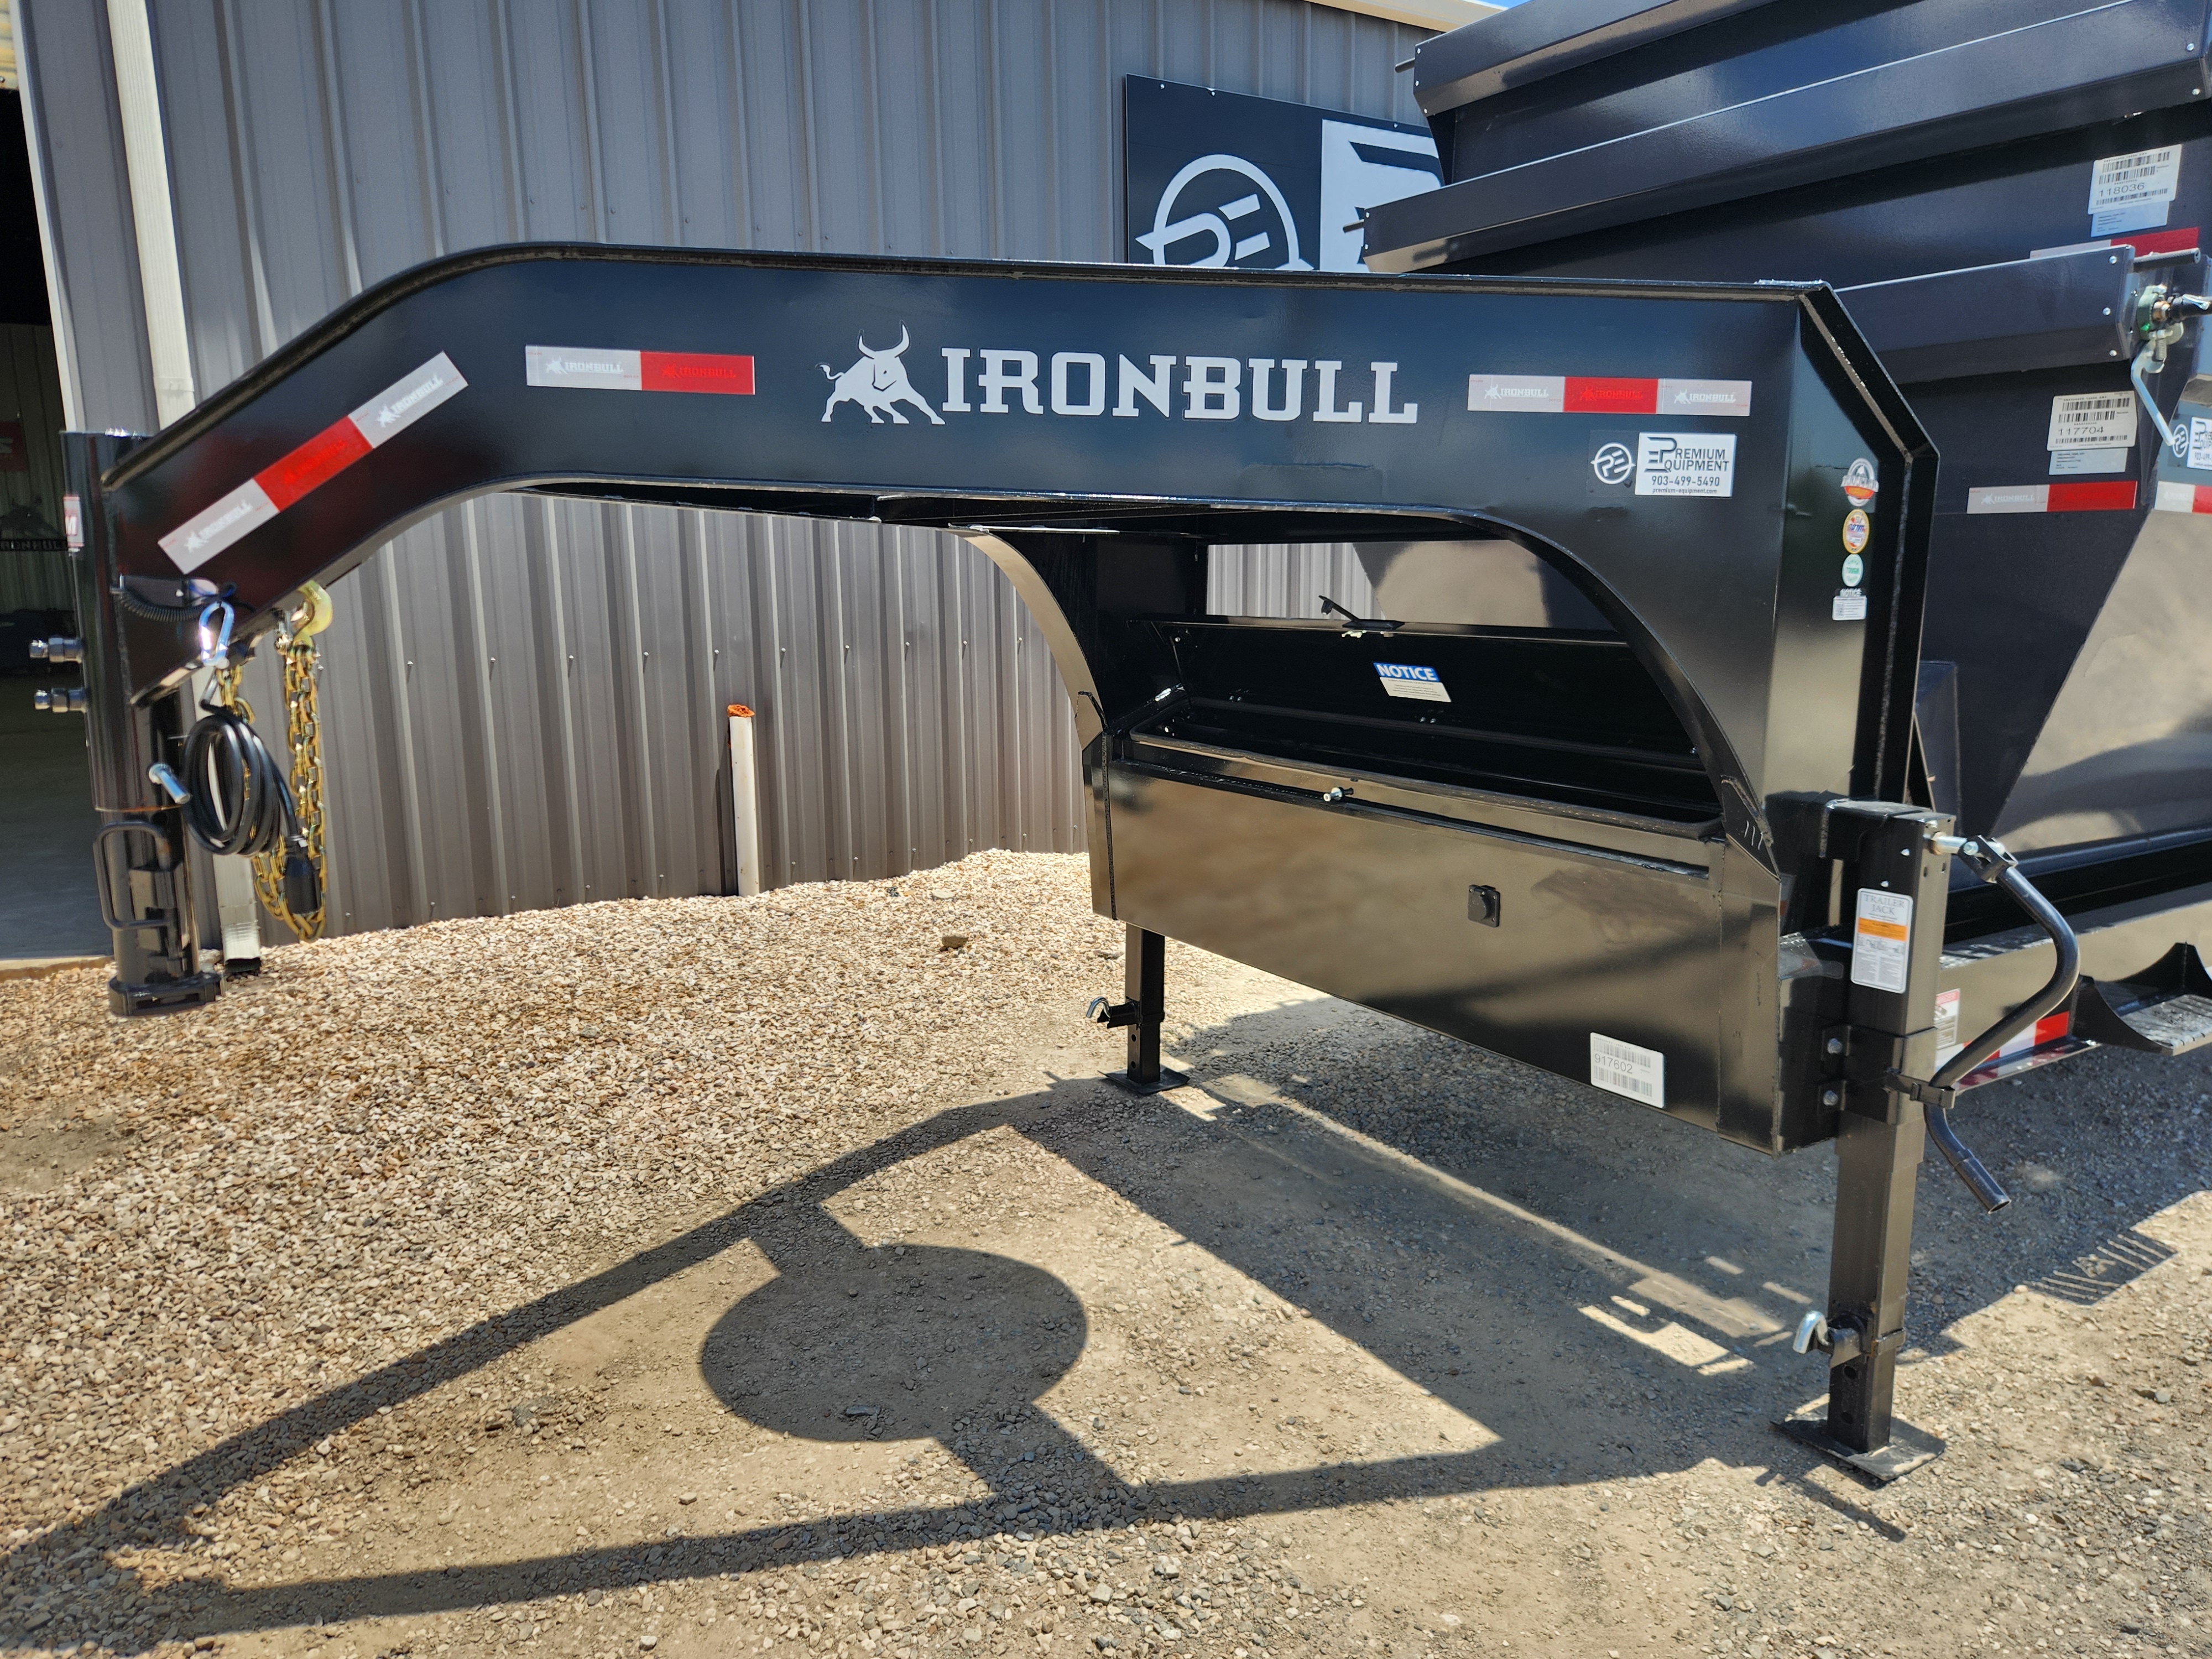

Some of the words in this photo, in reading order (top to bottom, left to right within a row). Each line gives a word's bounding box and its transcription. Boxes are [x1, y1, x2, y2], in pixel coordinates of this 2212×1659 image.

[2099, 182, 2145, 197] 118036
[565, 361, 624, 374] IRONBULL
[941, 347, 1418, 424] IRONBULL
[390, 374, 443, 415] IRONBULL
[1500, 388, 1549, 398] IRONBULL
[1595, 389, 1643, 400] IRONBULL
[1689, 392, 1736, 403] IRONBULL
[2058, 426, 2104, 436] 117704
[1647, 436, 1725, 460] PREMIUM
[1644, 451, 1729, 472] EQUIPMENT
[1651, 476, 1720, 487] 903-499-5490
[1376, 664, 1437, 681] NOTICE
[1864, 894, 1905, 908] TRAILER
[1872, 904, 1896, 916] JACK
[1594, 1053, 1633, 1074] 917602
